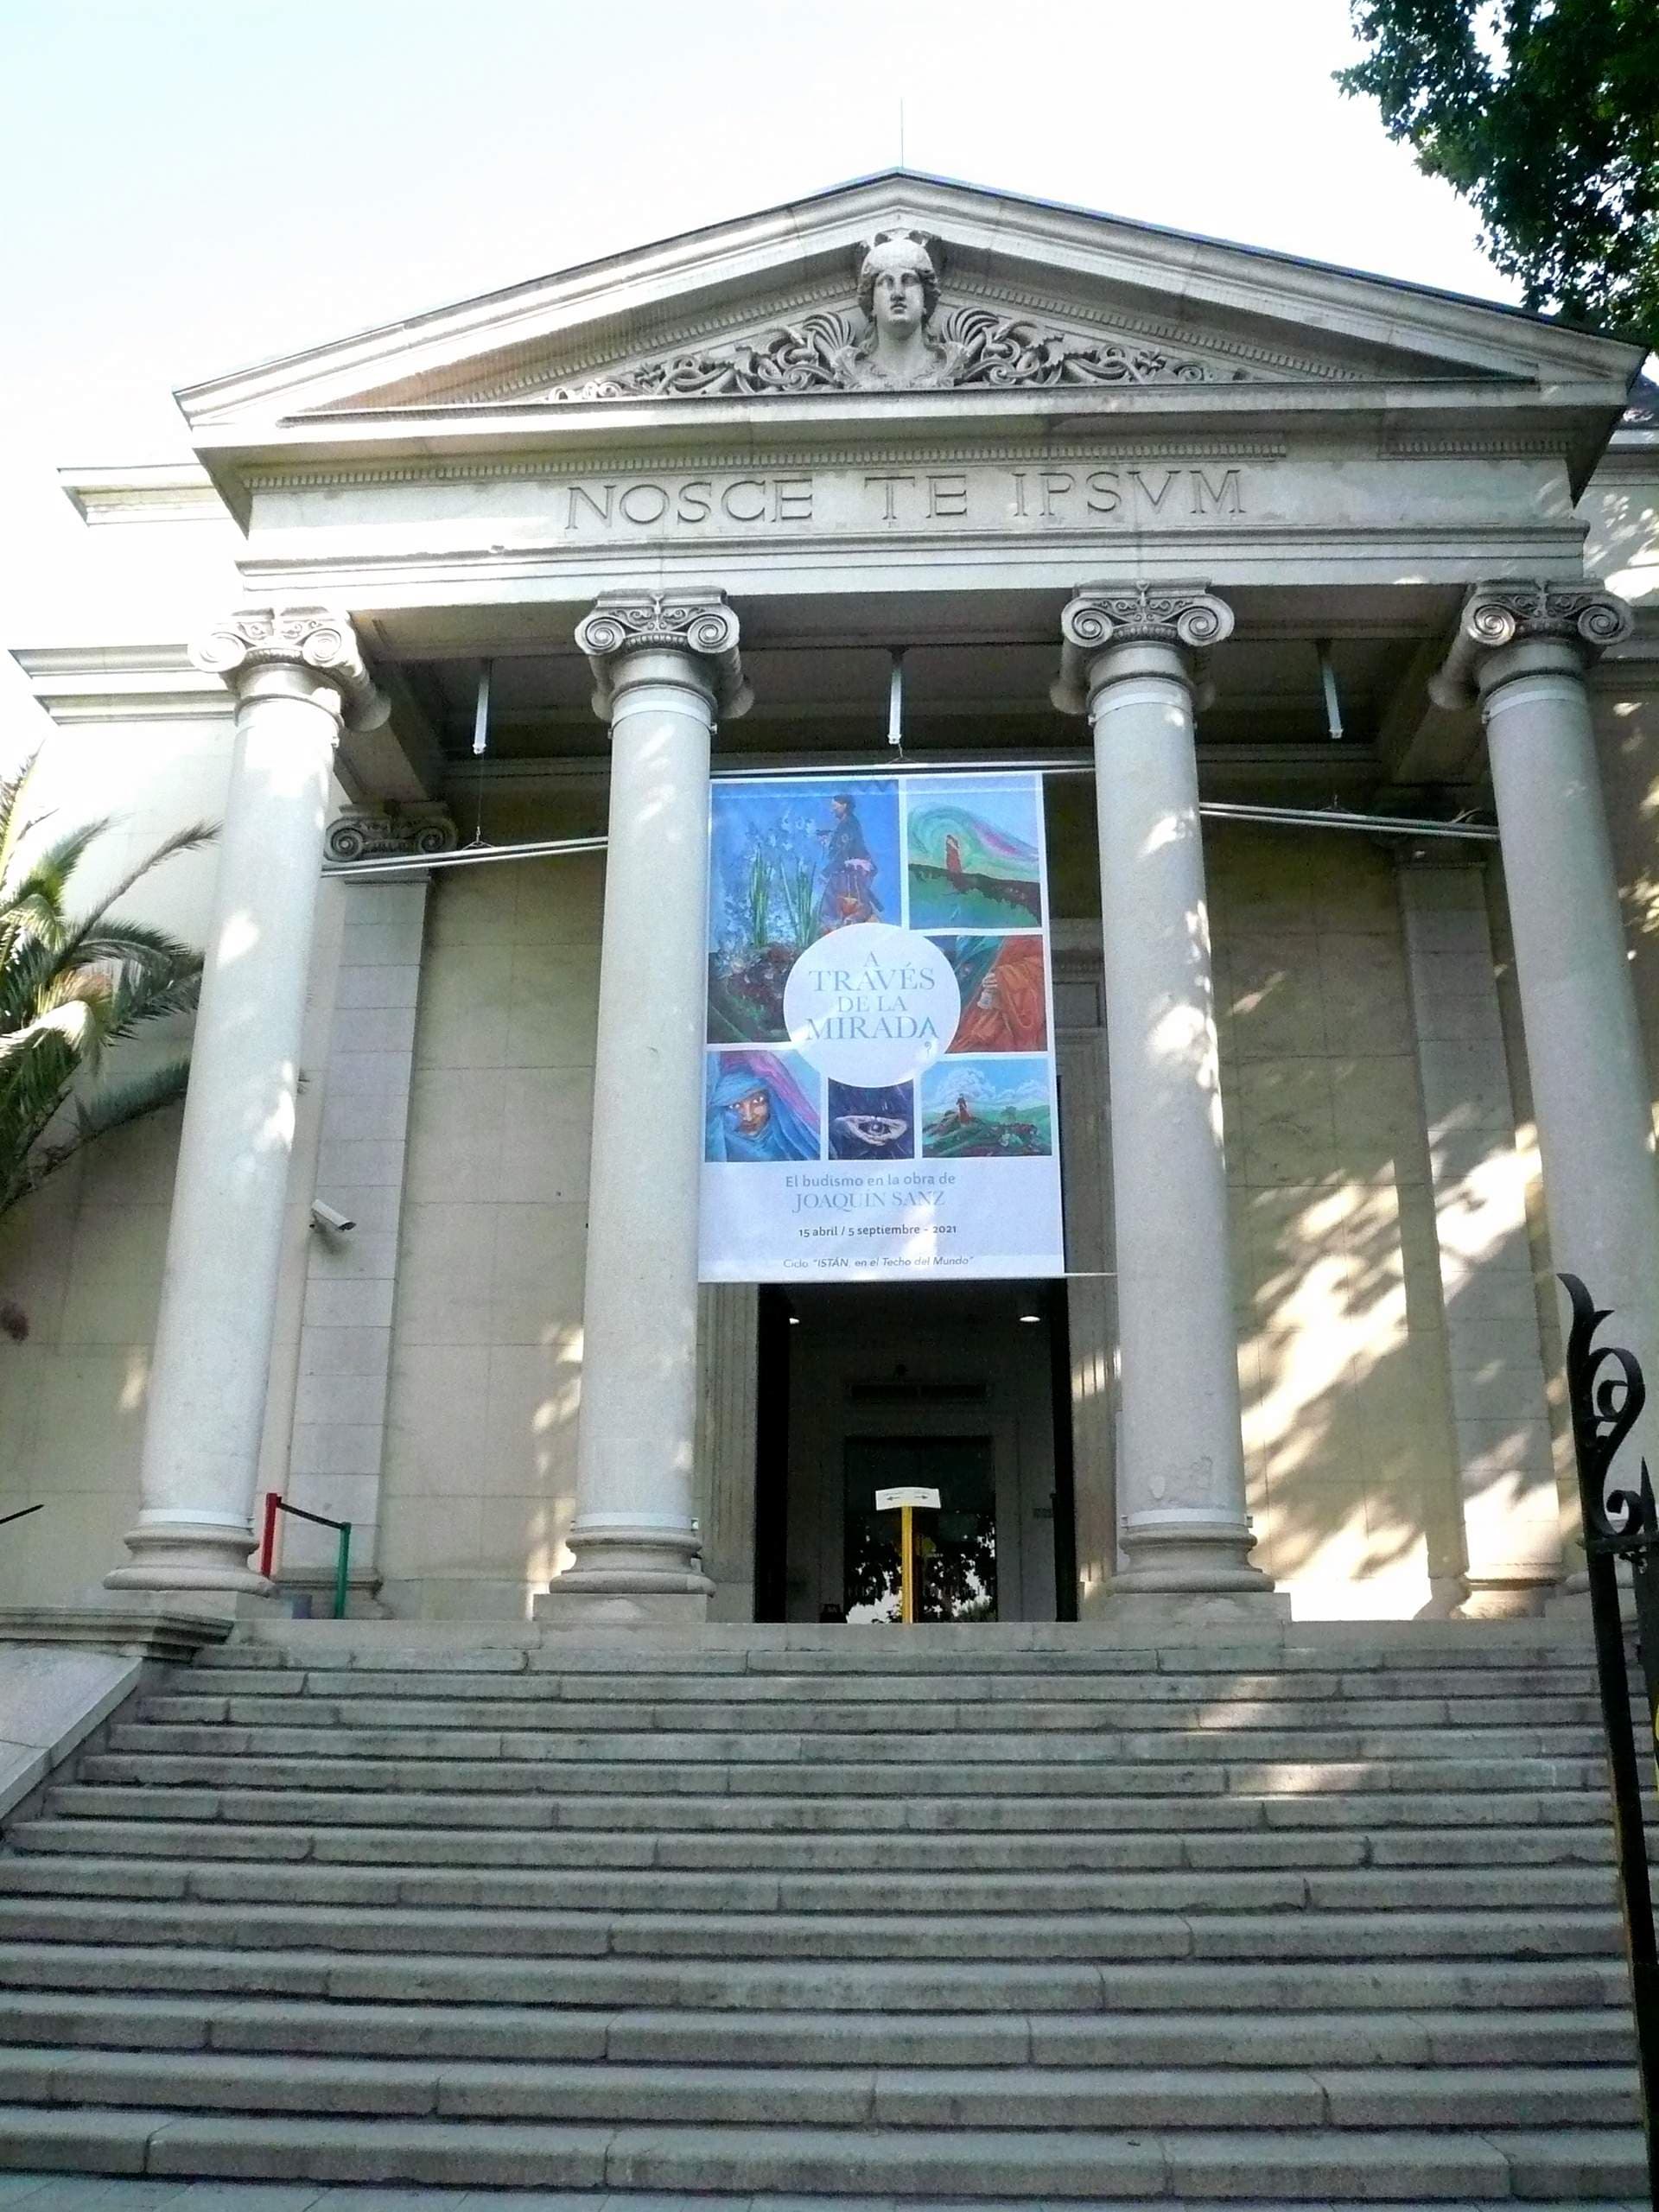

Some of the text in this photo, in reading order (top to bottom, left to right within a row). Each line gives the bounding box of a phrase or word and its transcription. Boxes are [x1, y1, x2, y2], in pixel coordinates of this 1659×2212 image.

[564, 468, 1247, 530] NOSCE TE IPSVM
[863, 951, 880, 967] A
[808, 962, 936, 992] TRAVÉS
[837, 995, 908, 1013] DE LA
[804, 1016, 940, 1040] MIRADA
[785, 1172, 956, 1188] El budismo en la obra de
[892, 1190, 946, 1206] SANZ
[798, 1229, 810, 1238] 15
[812, 1225, 838, 1236] abril
[848, 1227, 855, 1236] 5
[856, 1224, 920, 1237] septiembre
[932, 1224, 957, 1234] 2021
[783, 1257, 809, 1268] Ciclo
[870, 1256, 880, 1267] el
[882, 1256, 912, 1267] Techo
[914, 1255, 930, 1266] del
